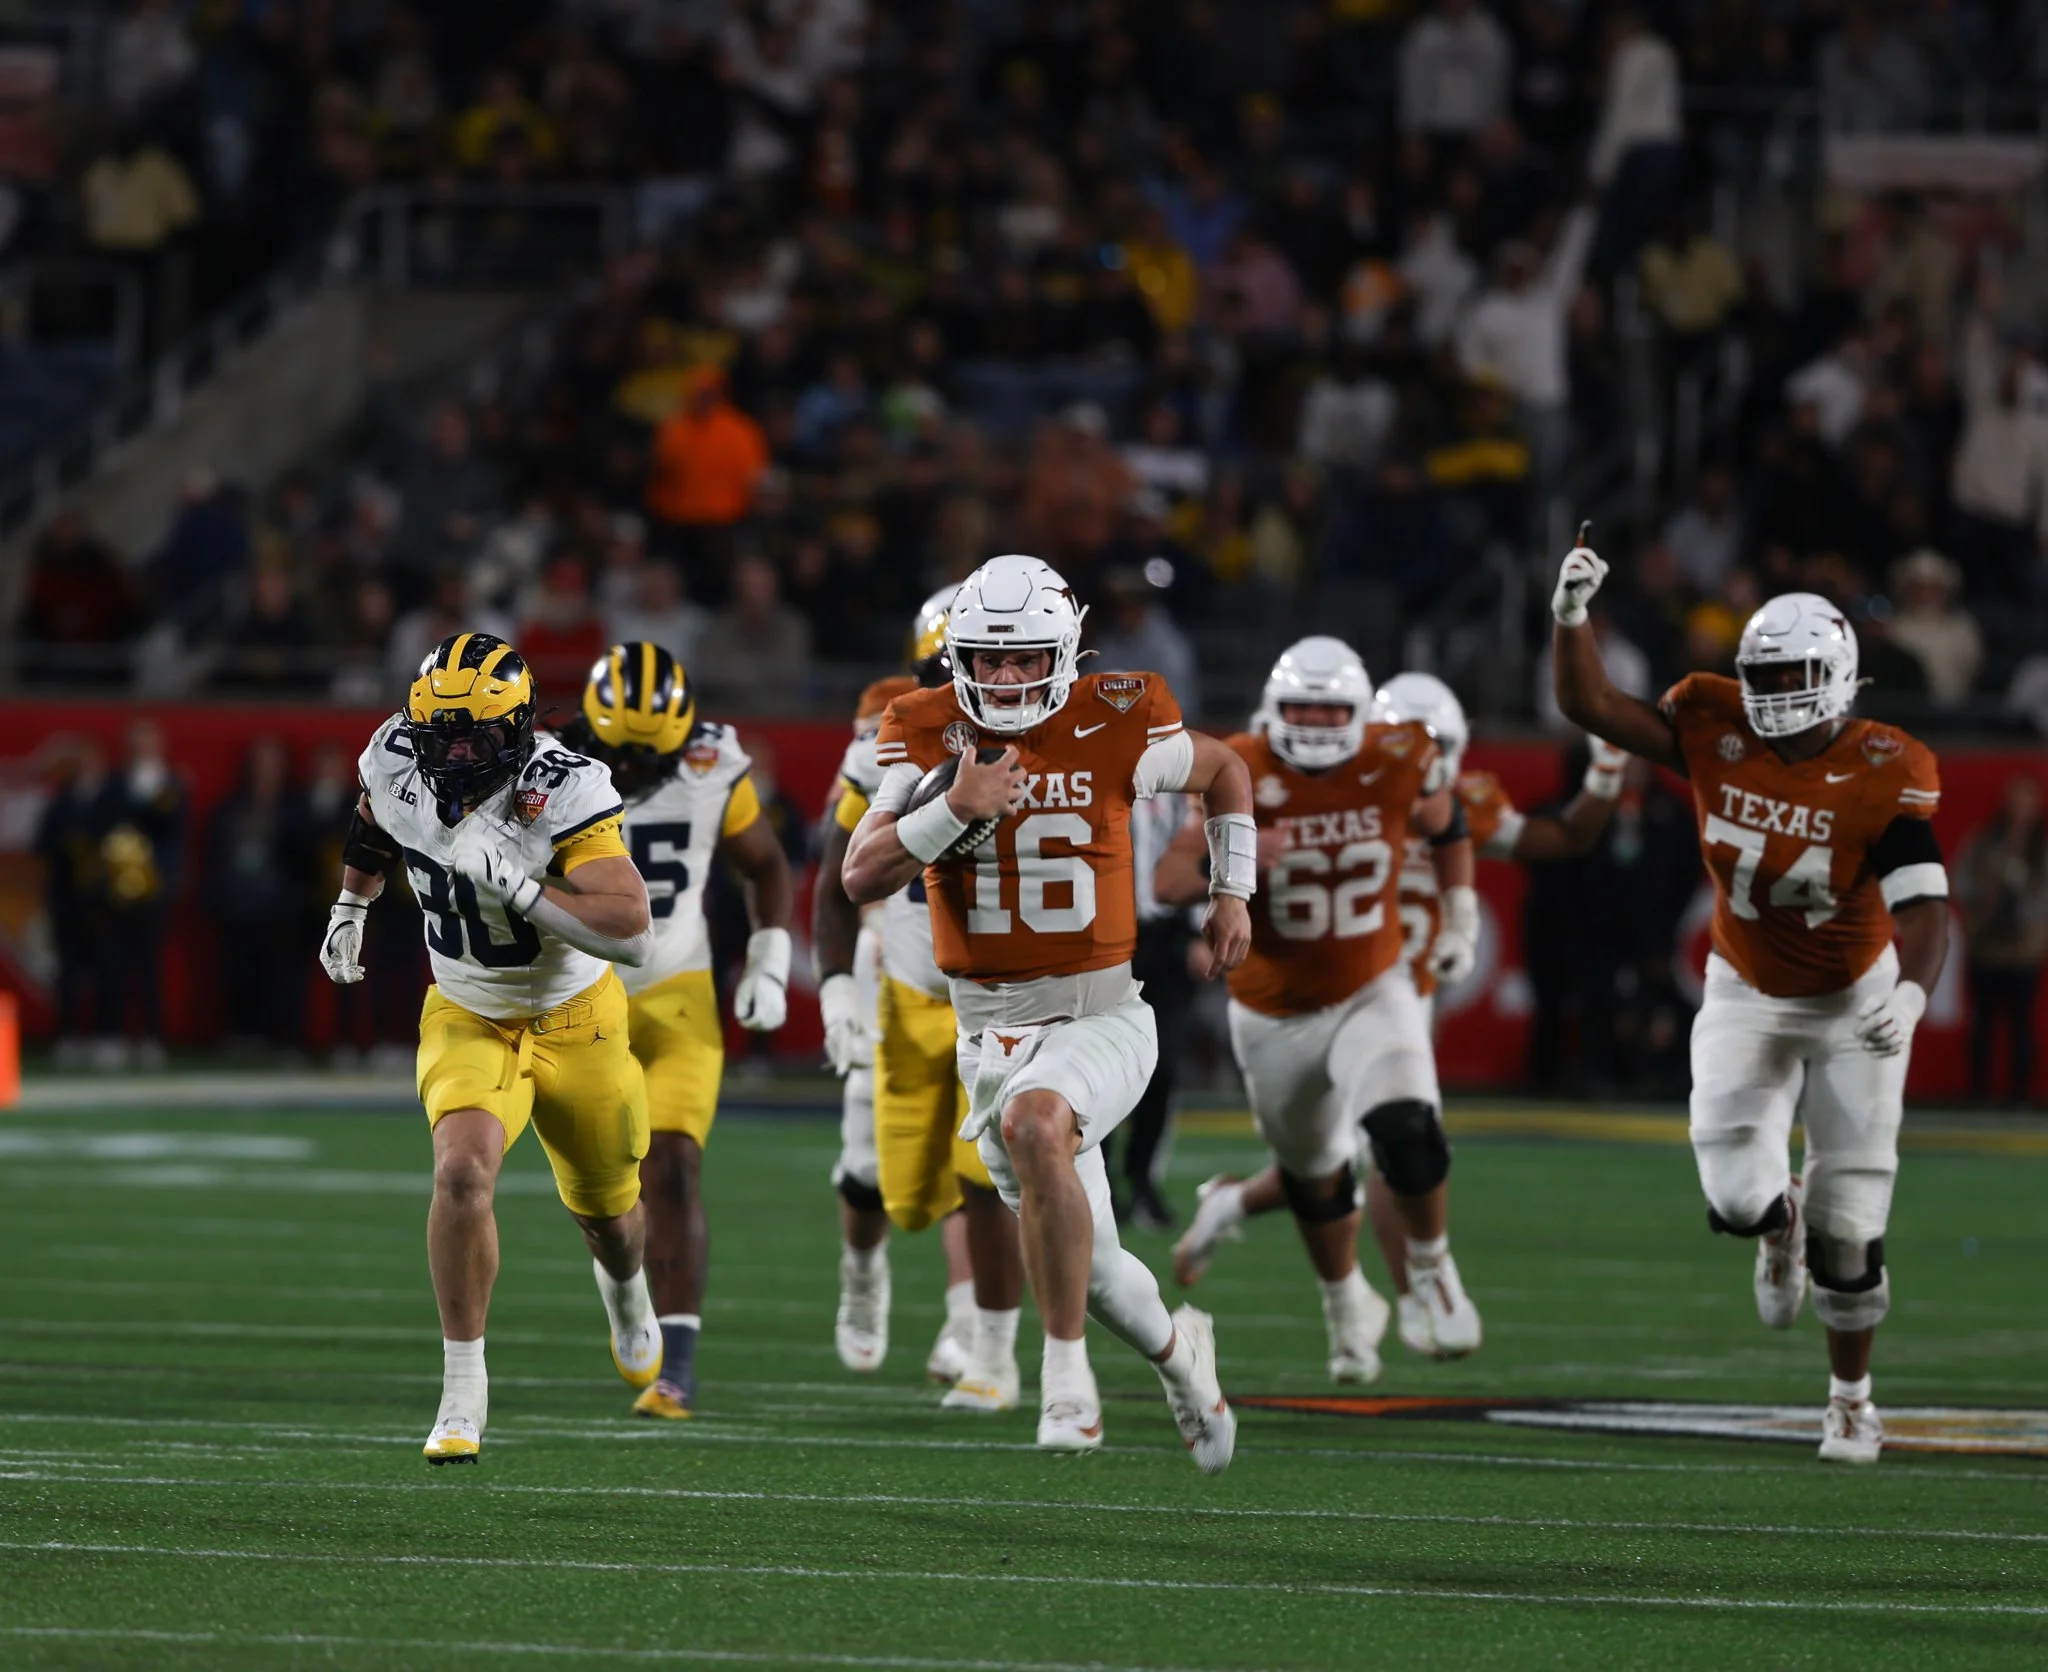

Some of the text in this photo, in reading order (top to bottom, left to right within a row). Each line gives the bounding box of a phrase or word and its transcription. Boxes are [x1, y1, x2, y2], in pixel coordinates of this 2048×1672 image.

[385, 719, 416, 760] 0
[443, 711, 456, 721] M
[523, 749, 592, 789] 30
[1014, 771, 1093, 809] XAS
[1274, 805, 1382, 849] TEXAS
[1720, 783, 1835, 842] TEXAS
[967, 812, 1097, 934] 16
[1268, 839, 1392, 940] 62
[1704, 812, 1842, 930] 74
[403, 846, 542, 968] 30
